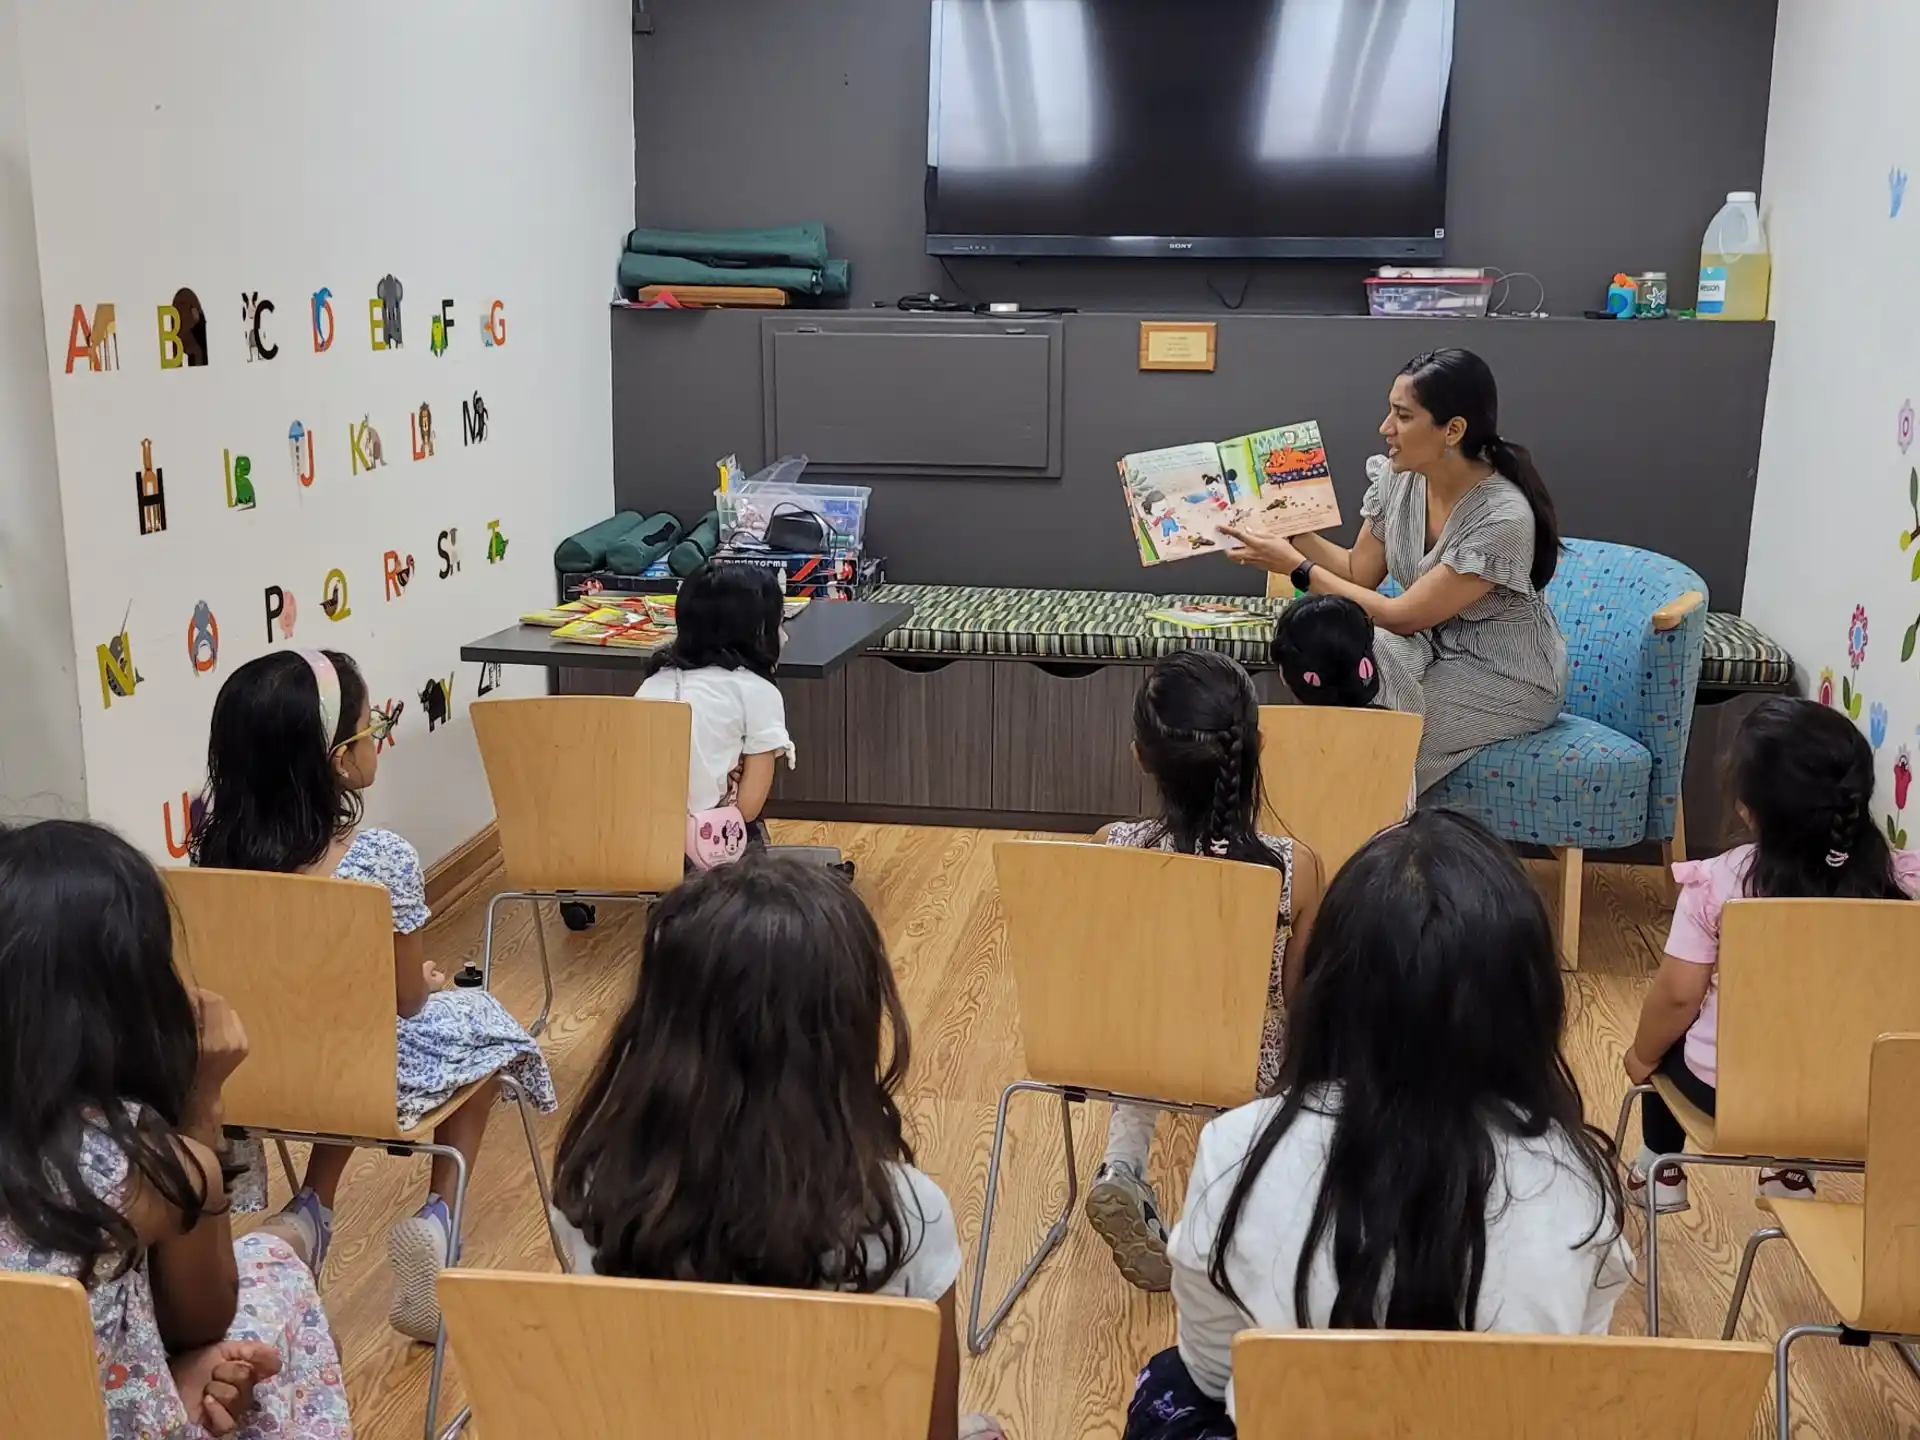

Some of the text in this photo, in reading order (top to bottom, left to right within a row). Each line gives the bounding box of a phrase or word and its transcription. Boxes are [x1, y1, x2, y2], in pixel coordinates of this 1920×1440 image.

[65, 298, 505, 374] A B C D E F G
[135, 399, 484, 535] H I J K L M
[96, 520, 500, 709] N O P Q R S T
[163, 791, 193, 859] U
[440, 671, 454, 721] Y
[1662, 1167, 1678, 1178] NIKE
[1785, 1171, 1805, 1183] NIKE
